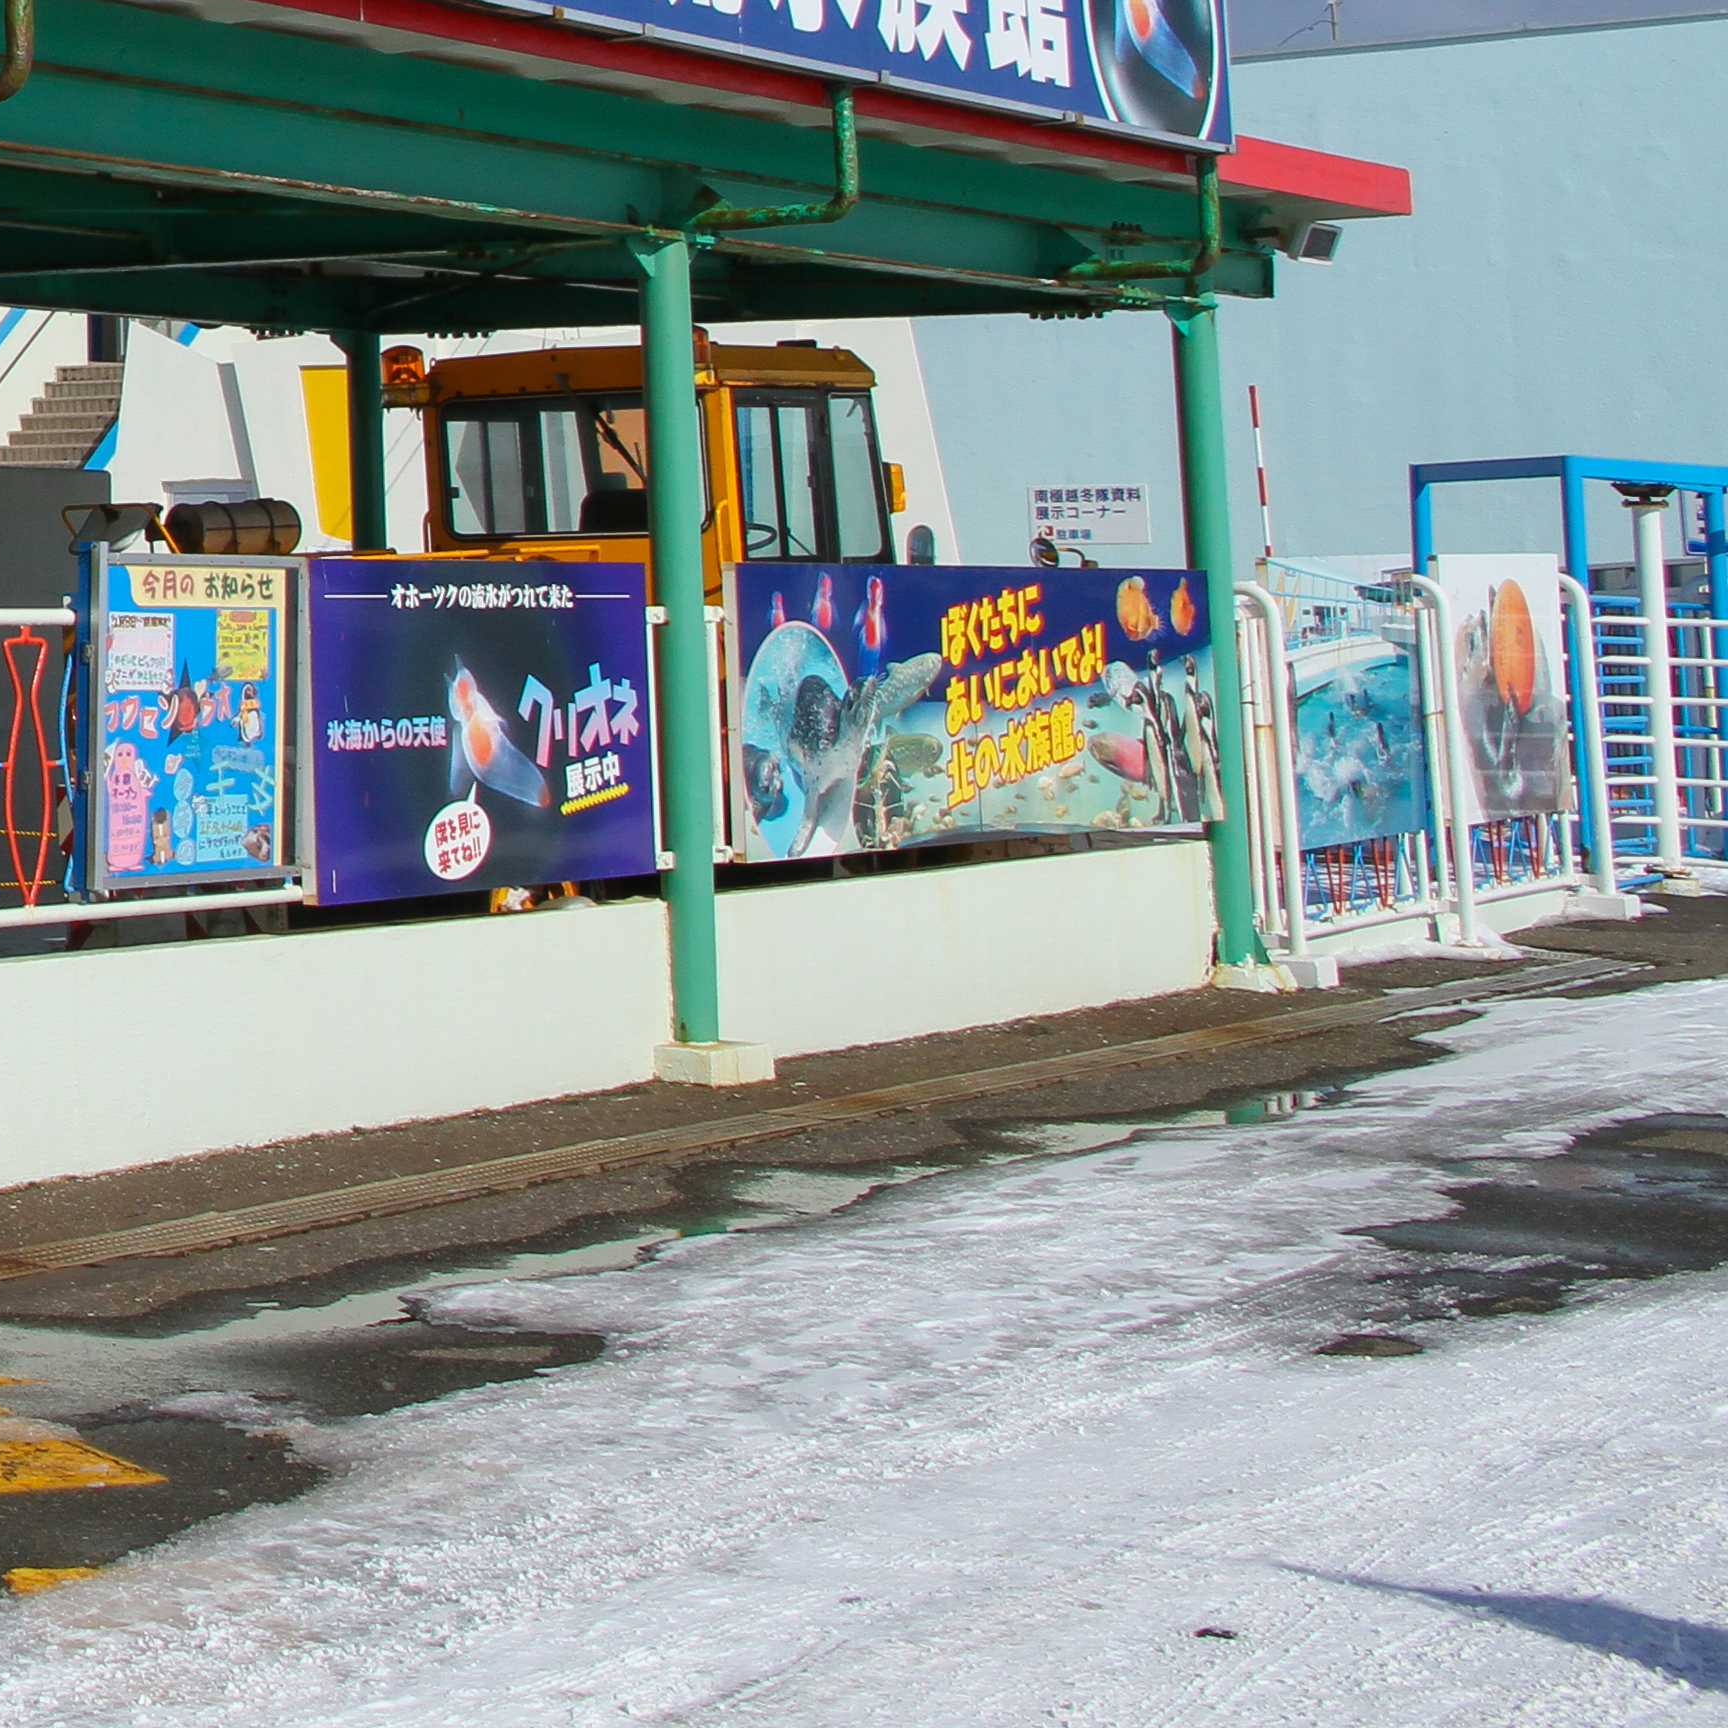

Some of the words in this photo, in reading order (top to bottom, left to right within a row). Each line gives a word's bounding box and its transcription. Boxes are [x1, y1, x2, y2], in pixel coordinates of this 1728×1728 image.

[1036, 505, 1125, 520] 展示コーナー
[142, 570, 194, 600] 今月の
[204, 571, 273, 601] お知らせ
[390, 583, 574, 609] オホーツクの流氷がつれて来た
[940, 584, 1042, 666] ぼくたちに
[326, 715, 449, 752] 氷海からの天使
[518, 663, 640, 769] クリオネ
[565, 751, 621, 799] 展示中
